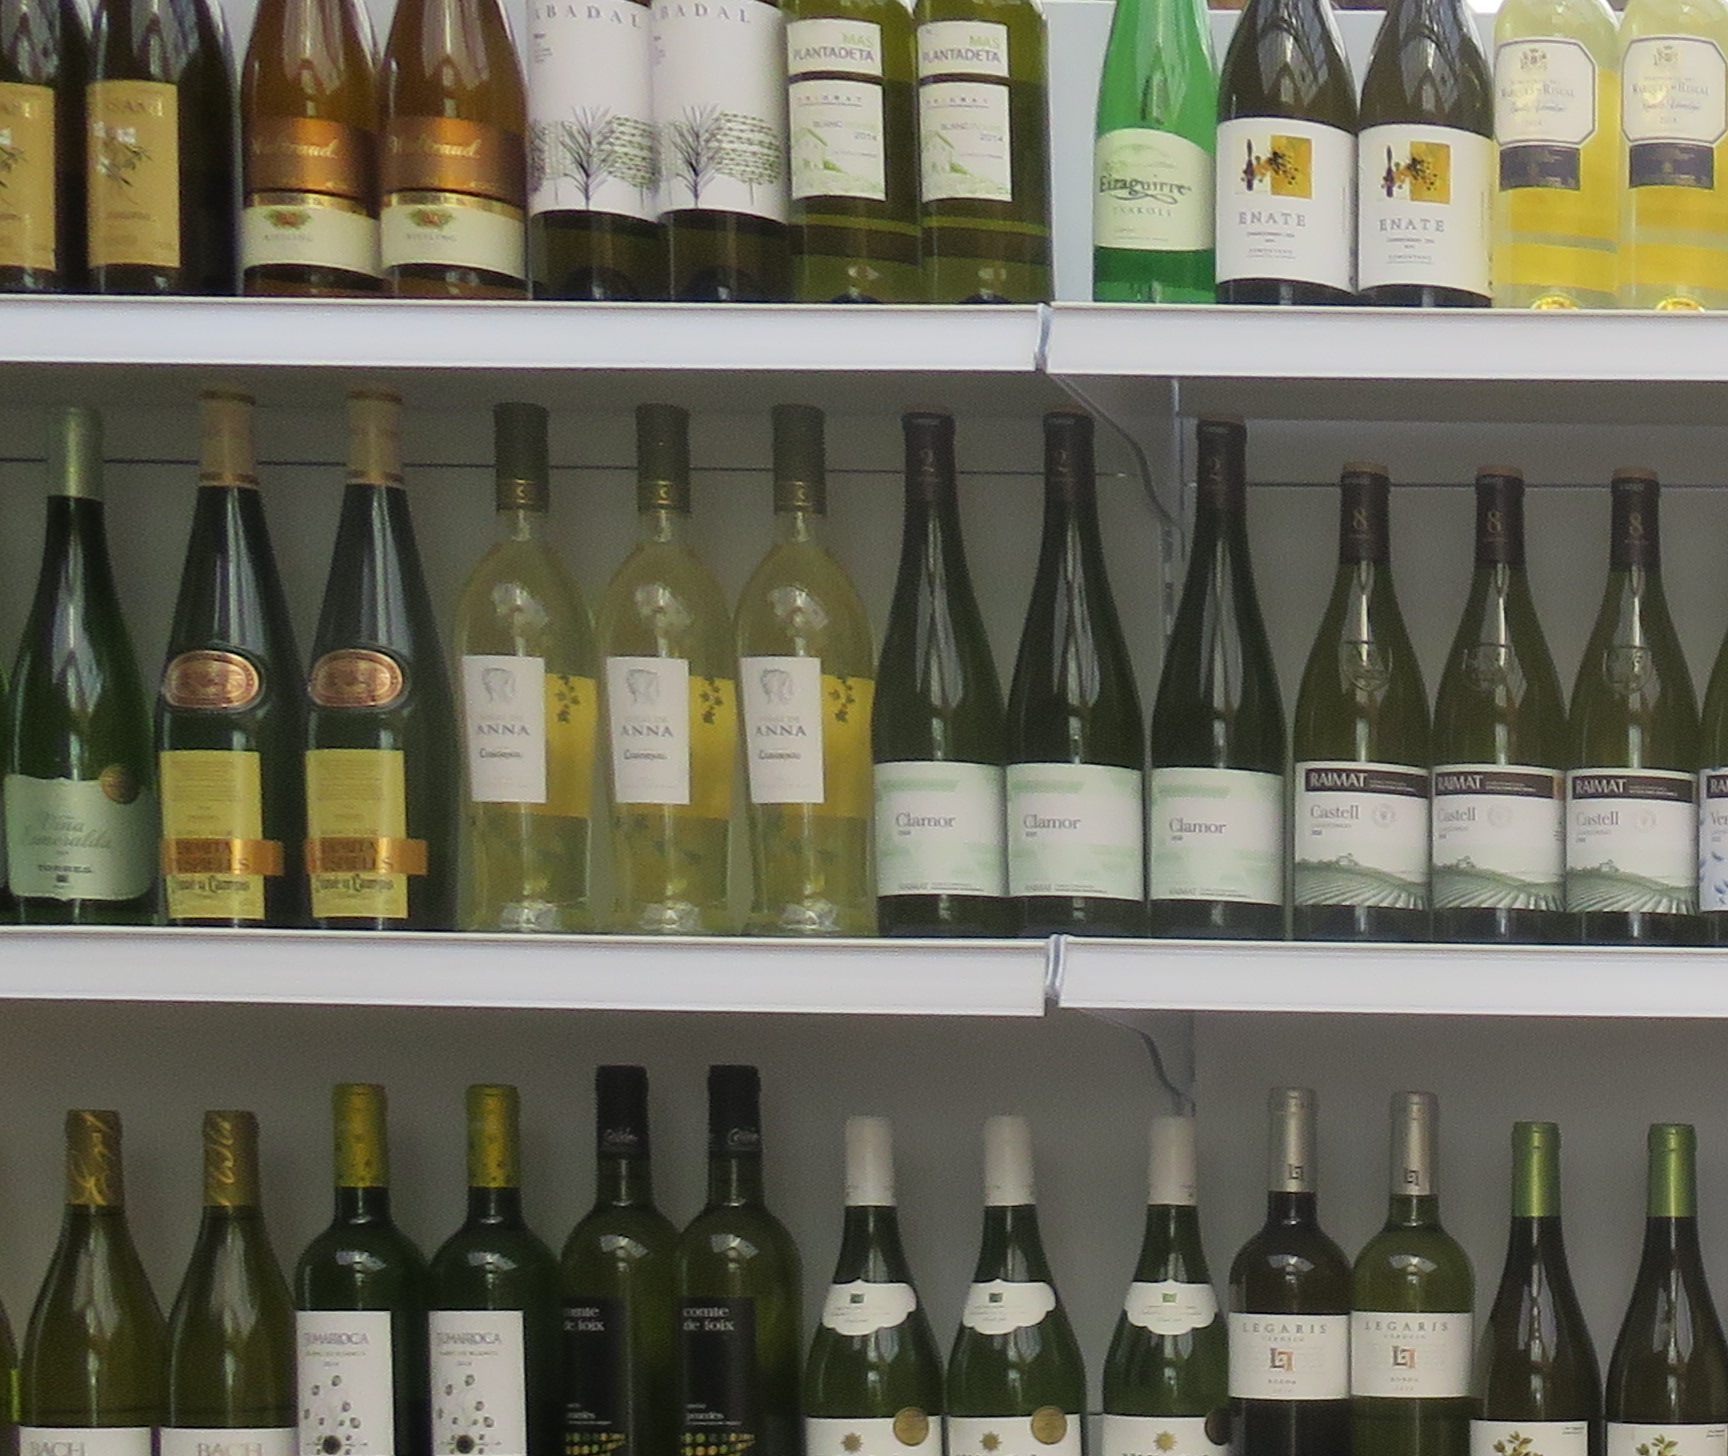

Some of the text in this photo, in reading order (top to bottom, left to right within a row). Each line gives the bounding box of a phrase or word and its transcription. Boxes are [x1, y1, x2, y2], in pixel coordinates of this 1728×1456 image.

[1239, 211, 1308, 229] ENATE
[1379, 217, 1446, 234] ENATE
[476, 723, 533, 737] ANNA
[620, 724, 675, 738] ANNA
[754, 724, 808, 738] ANNA
[1308, 771, 1368, 789] RAIMAT
[1437, 772, 1484, 791] RAIMAT
[1575, 777, 1627, 795] RAIMAT
[894, 812, 957, 831] Clamor
[1023, 812, 1082, 831] Clamor
[1310, 803, 1360, 822] Castell
[1437, 805, 1477, 823] Castell
[1169, 817, 1228, 836] Clamor
